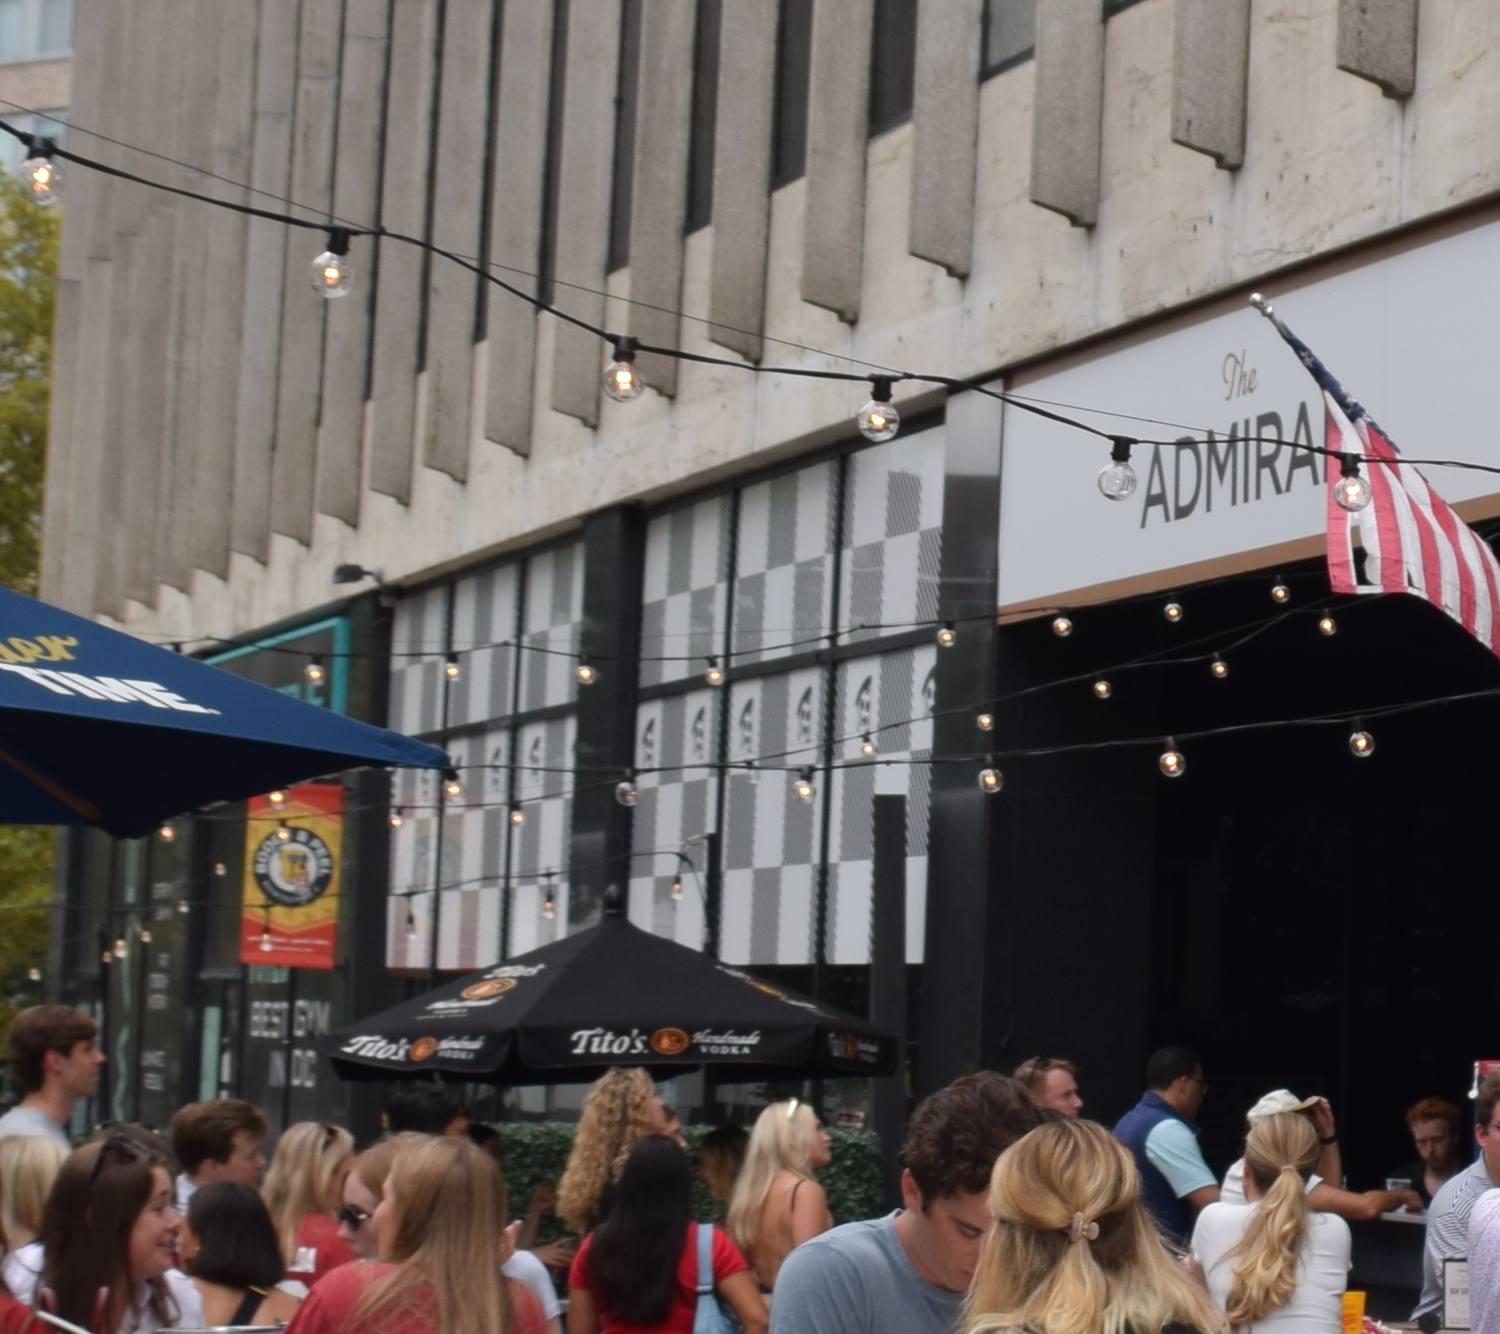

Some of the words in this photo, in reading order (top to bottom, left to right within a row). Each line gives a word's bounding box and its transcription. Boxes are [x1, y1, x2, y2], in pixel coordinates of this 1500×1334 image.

[1222, 349, 1258, 401] The
[1140, 400, 1329, 530] ADMIRA
[250, 1000, 289, 1038] BEST
[292, 999, 331, 1037] GYM
[341, 1034, 411, 1062] Tito's
[570, 1026, 648, 1056] Tito's
[692, 1028, 761, 1045] Handmade
[700, 1044, 750, 1055] VODKA
[291, 1048, 318, 1088] DC
